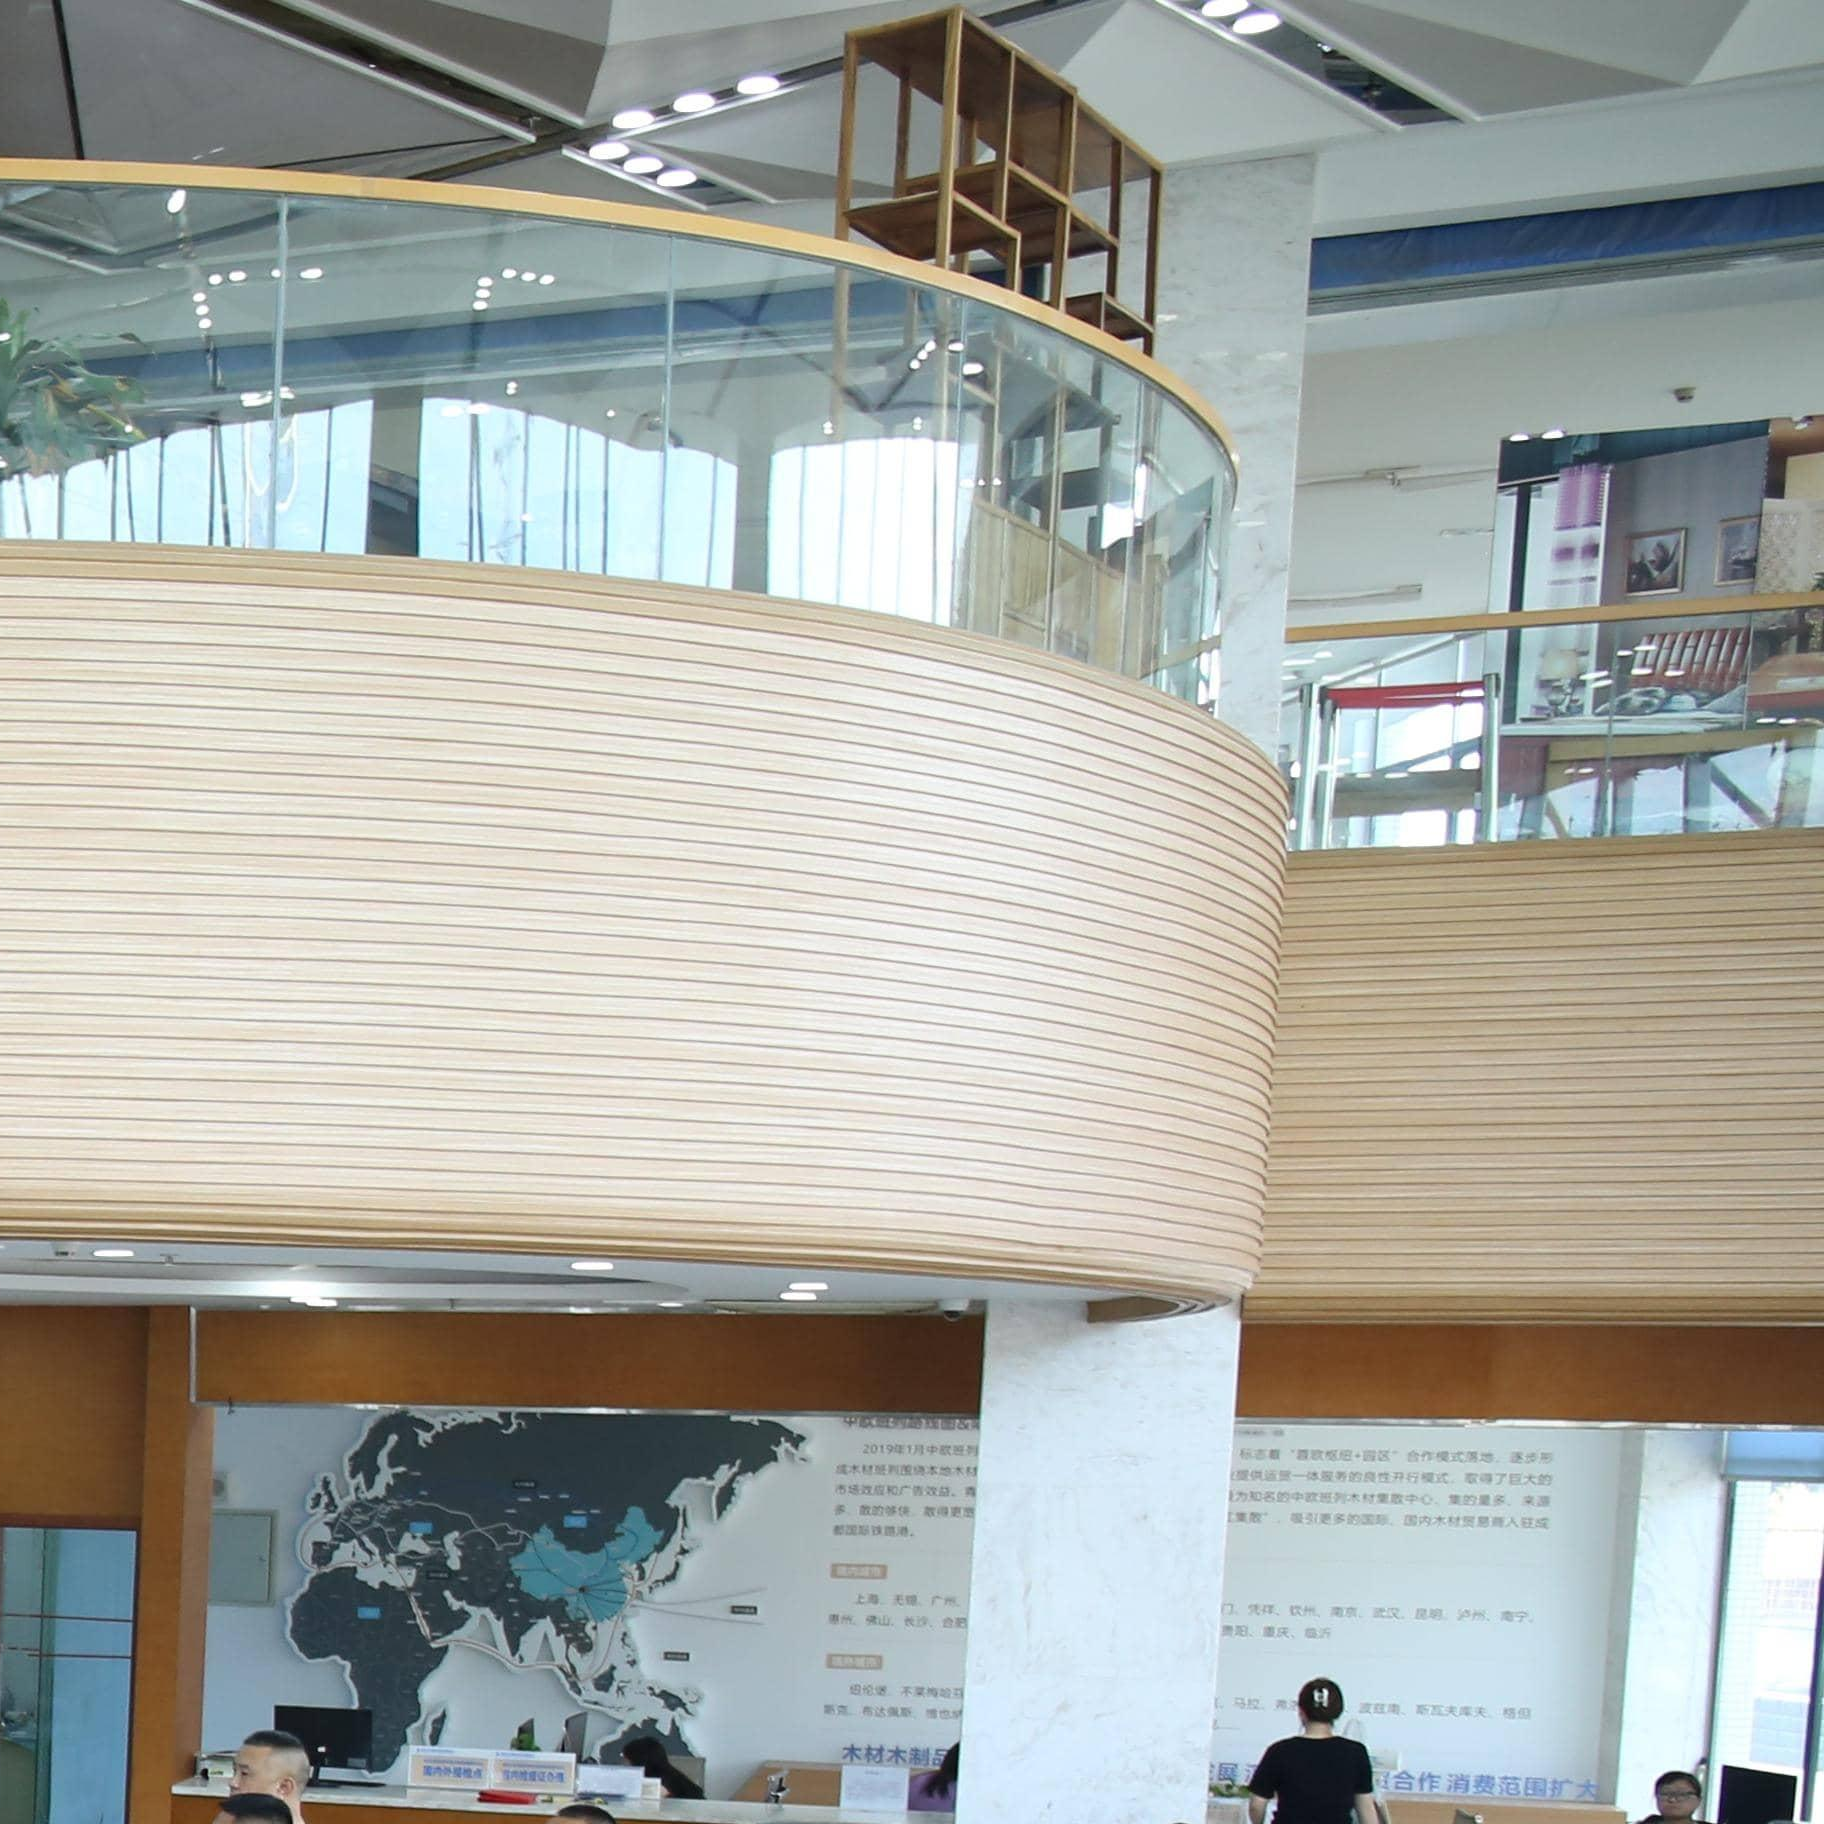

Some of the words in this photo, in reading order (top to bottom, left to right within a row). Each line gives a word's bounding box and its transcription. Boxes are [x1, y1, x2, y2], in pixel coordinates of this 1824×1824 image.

[842, 1743, 949, 1767] 木材木制品
[1446, 1772, 1601, 1800] 消费范围扩大
